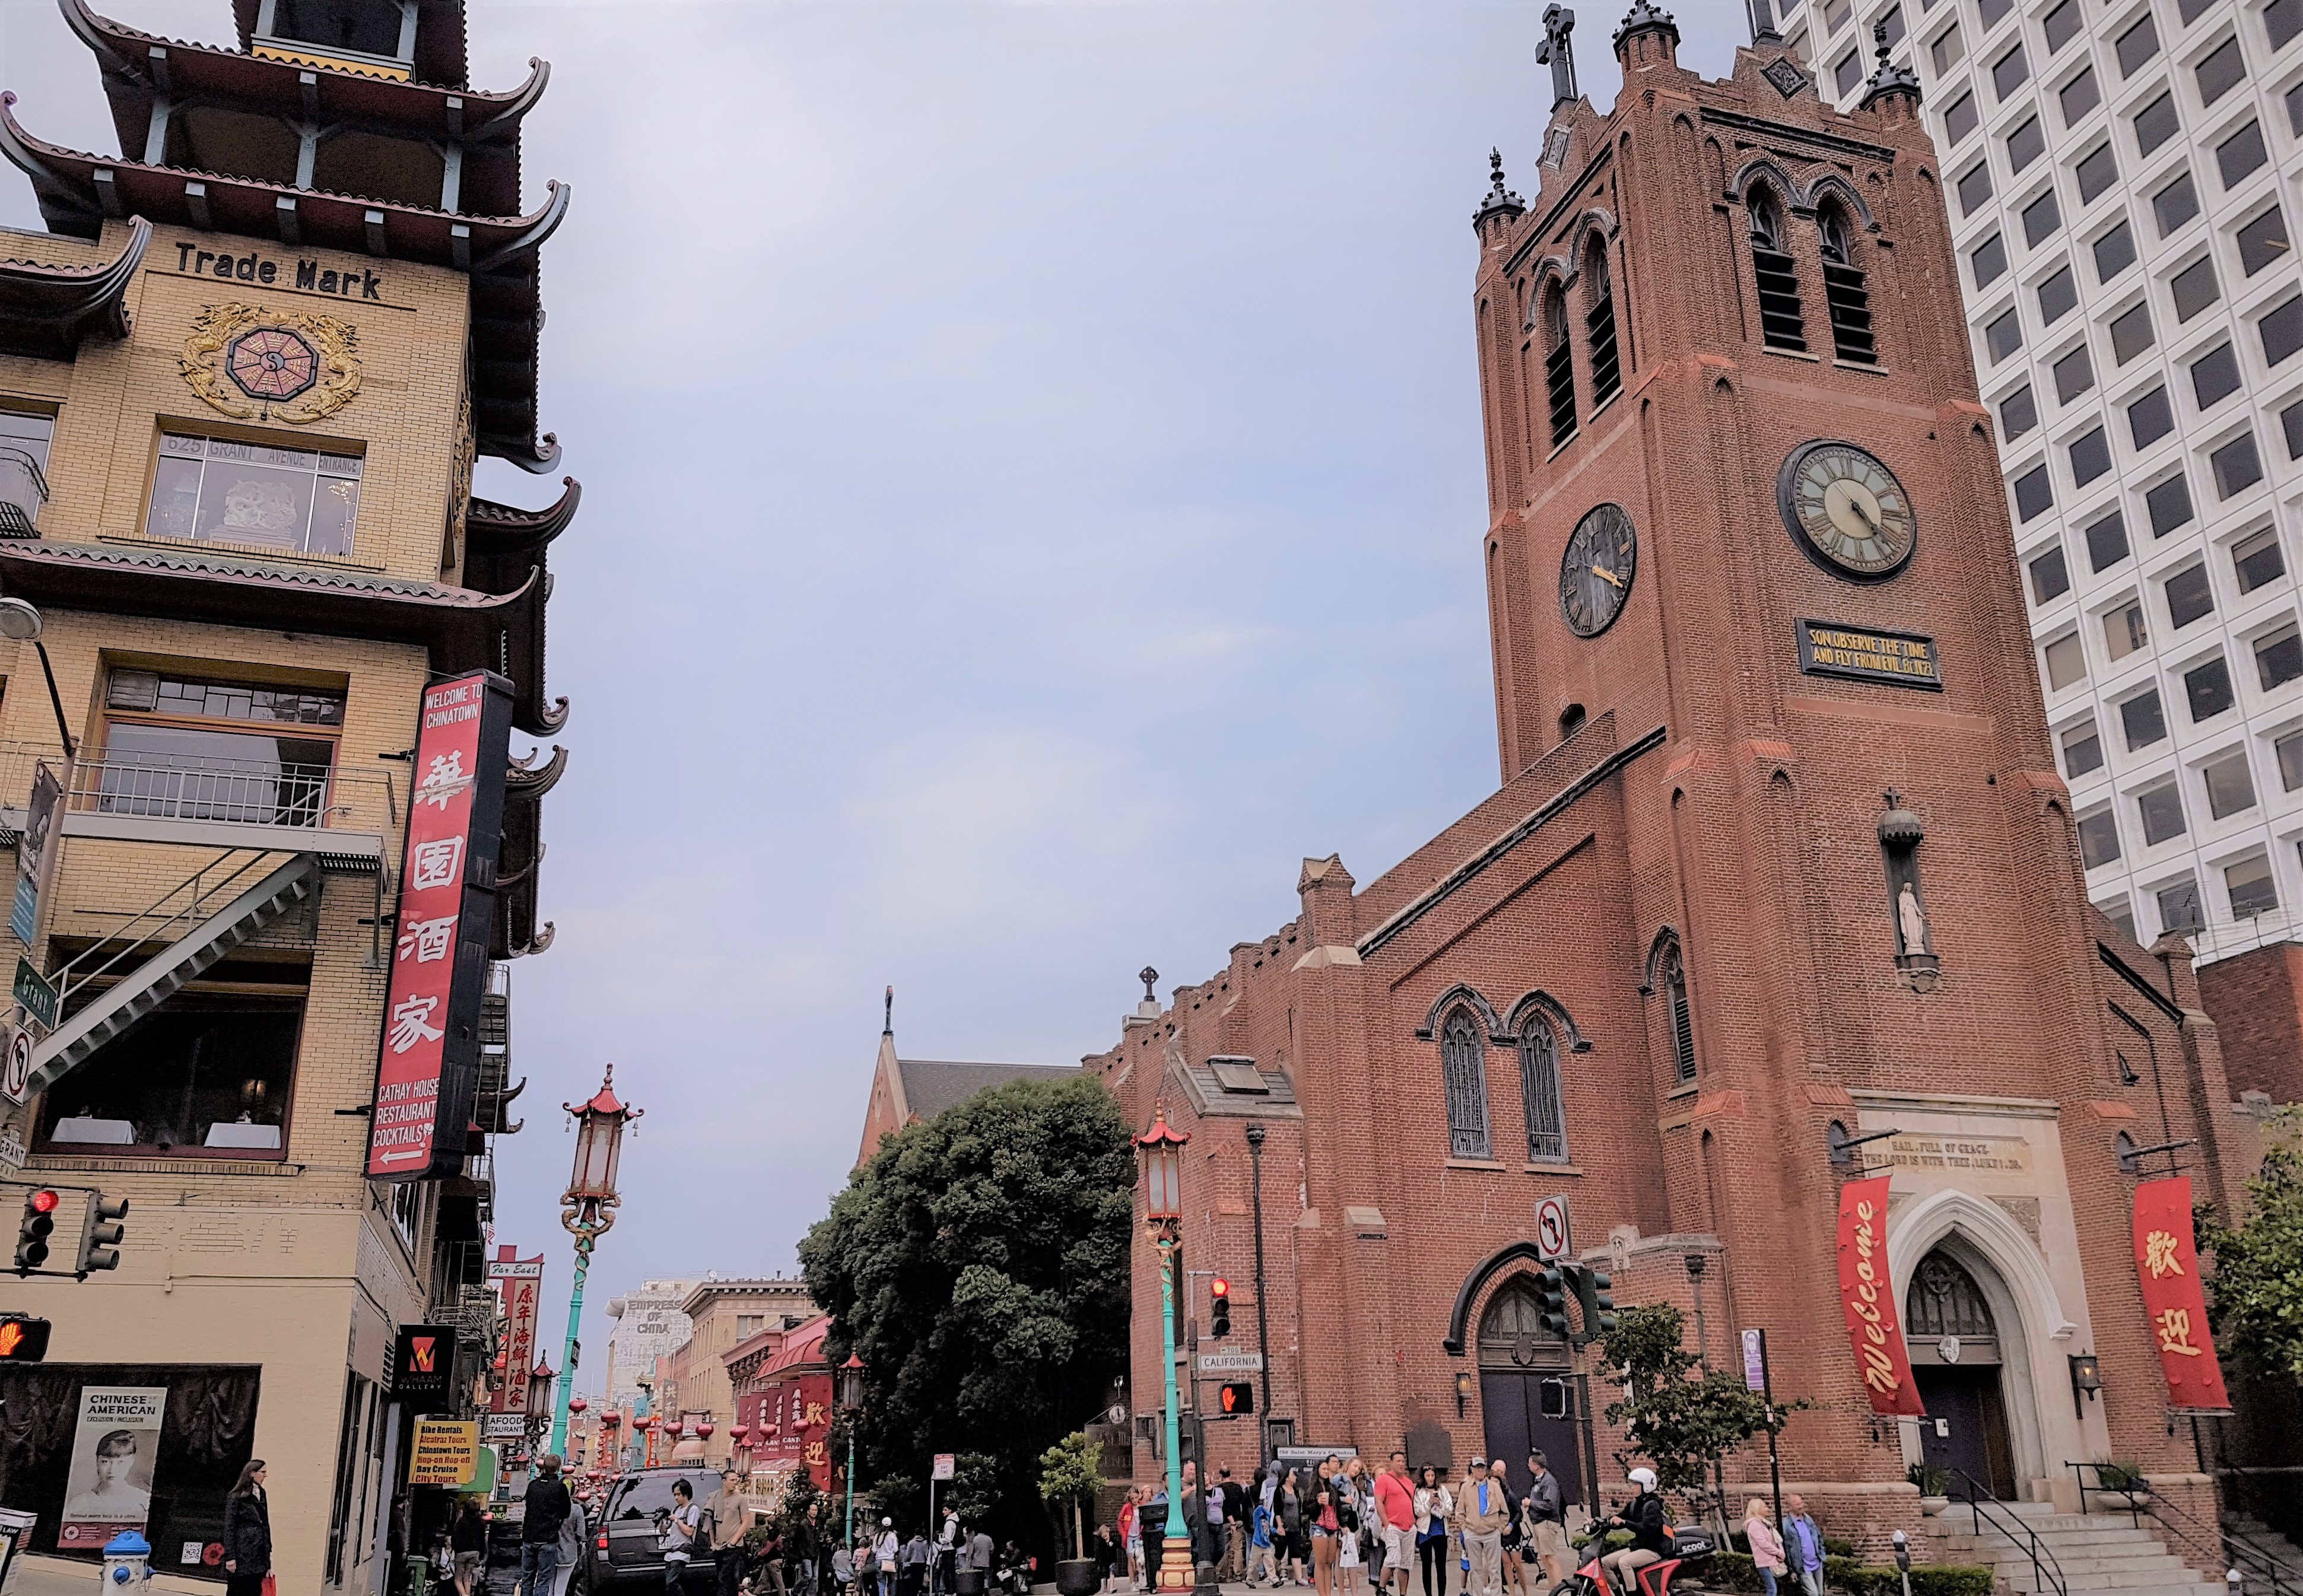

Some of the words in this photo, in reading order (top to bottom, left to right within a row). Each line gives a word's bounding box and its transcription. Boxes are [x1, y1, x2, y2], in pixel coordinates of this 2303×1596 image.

[176, 241, 277, 284] Trade
[296, 259, 381, 300] Mark
[167, 435, 202, 453] 625
[210, 441, 254, 460] GRANT
[268, 449, 306, 466] AVENUE
[319, 454, 357, 473] ENTRANCE
[1833, 632, 1879, 653] OBSERVE
[1879, 638, 1901, 656] THE
[1902, 642, 1929, 660] TIME
[1813, 647, 1834, 664] AND
[1835, 650, 1852, 666] FLY
[1854, 652, 1882, 671] FROM
[426, 686, 469, 710] WELCOME
[471, 683, 483, 700] TO
[426, 702, 479, 729] CHINATOWN
[389, 750, 474, 1054] 華園酒家
[23, 974, 48, 1015] Grant
[379, 1082, 412, 1103] CATHAY
[412, 1077, 440, 1098] HOUSE
[376, 1100, 437, 1125] RESTAURANT
[373, 1124, 423, 1147] COCKTAILS
[0, 1140, 24, 1163] GRANT
[1920, 1142, 1942, 1153] FULL
[1945, 1143, 1956, 1153] OF
[492, 1264, 509, 1274] Far
[513, 1265, 537, 1274] East
[1851, 1198, 1899, 1395] Welcome
[2145, 1229, 2203, 1357] 歡迎
[627, 1299, 682, 1311] EMPRESS
[637, 1323, 670, 1334] CHINA
[647, 1312, 663, 1322] OF
[1204, 1357, 1257, 1367] CALIFORNIA
[401, 1376, 442, 1384] WHAAM
[87, 1406, 156, 1415] AMERICAN
[90, 1395, 147, 1404] CHINESE
[437, 1426, 463, 1434] Rentals
[418, 1446, 452, 1454] Chinatown
[415, 1474, 432, 1483] City
[1681, 1540, 1707, 1553] scoot
